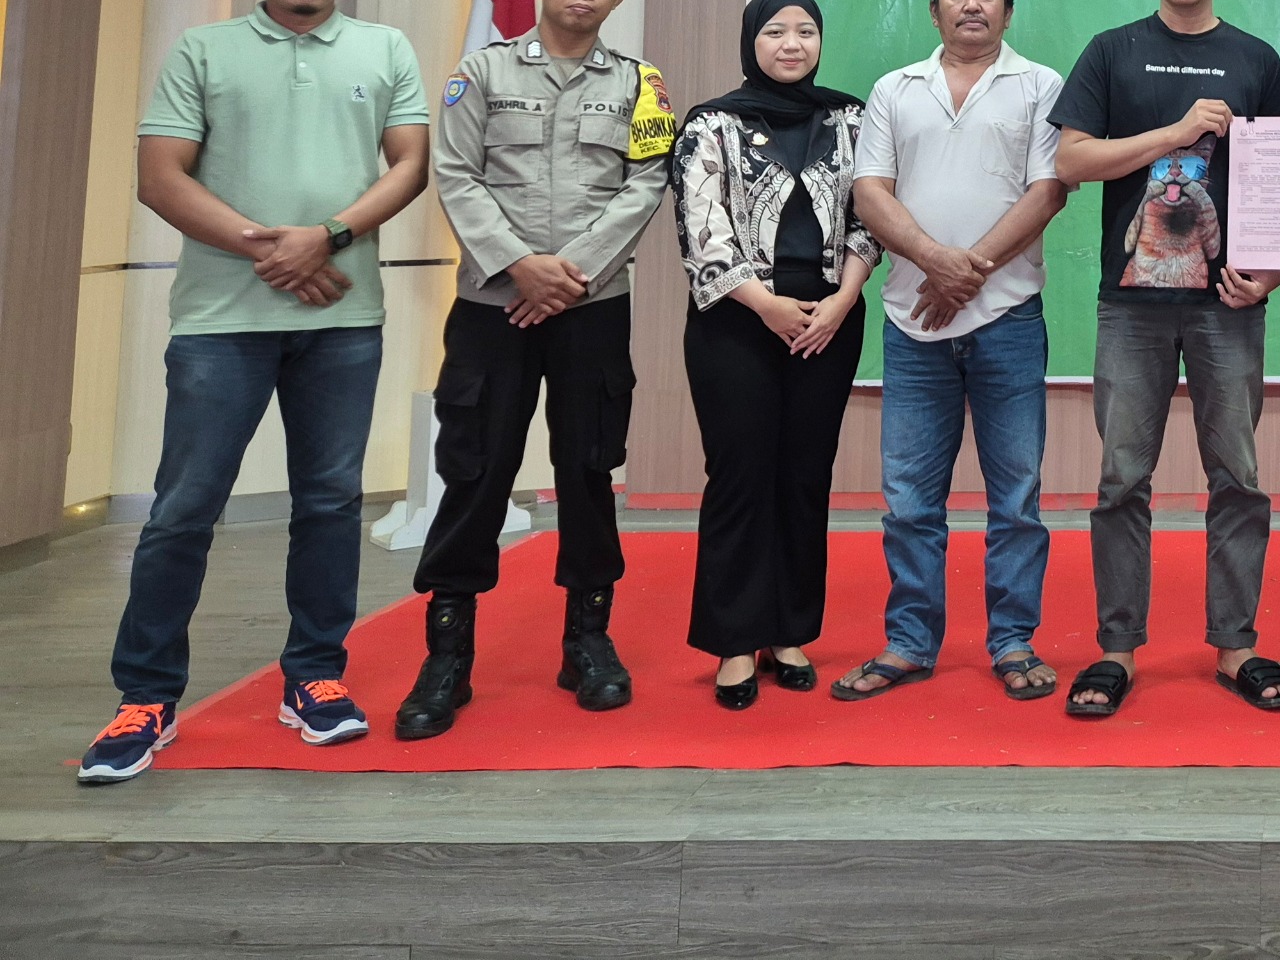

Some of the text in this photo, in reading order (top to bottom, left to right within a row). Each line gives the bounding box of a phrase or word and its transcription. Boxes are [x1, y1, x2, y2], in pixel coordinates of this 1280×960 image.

[1145, 64, 1225, 77] Same shit different day
